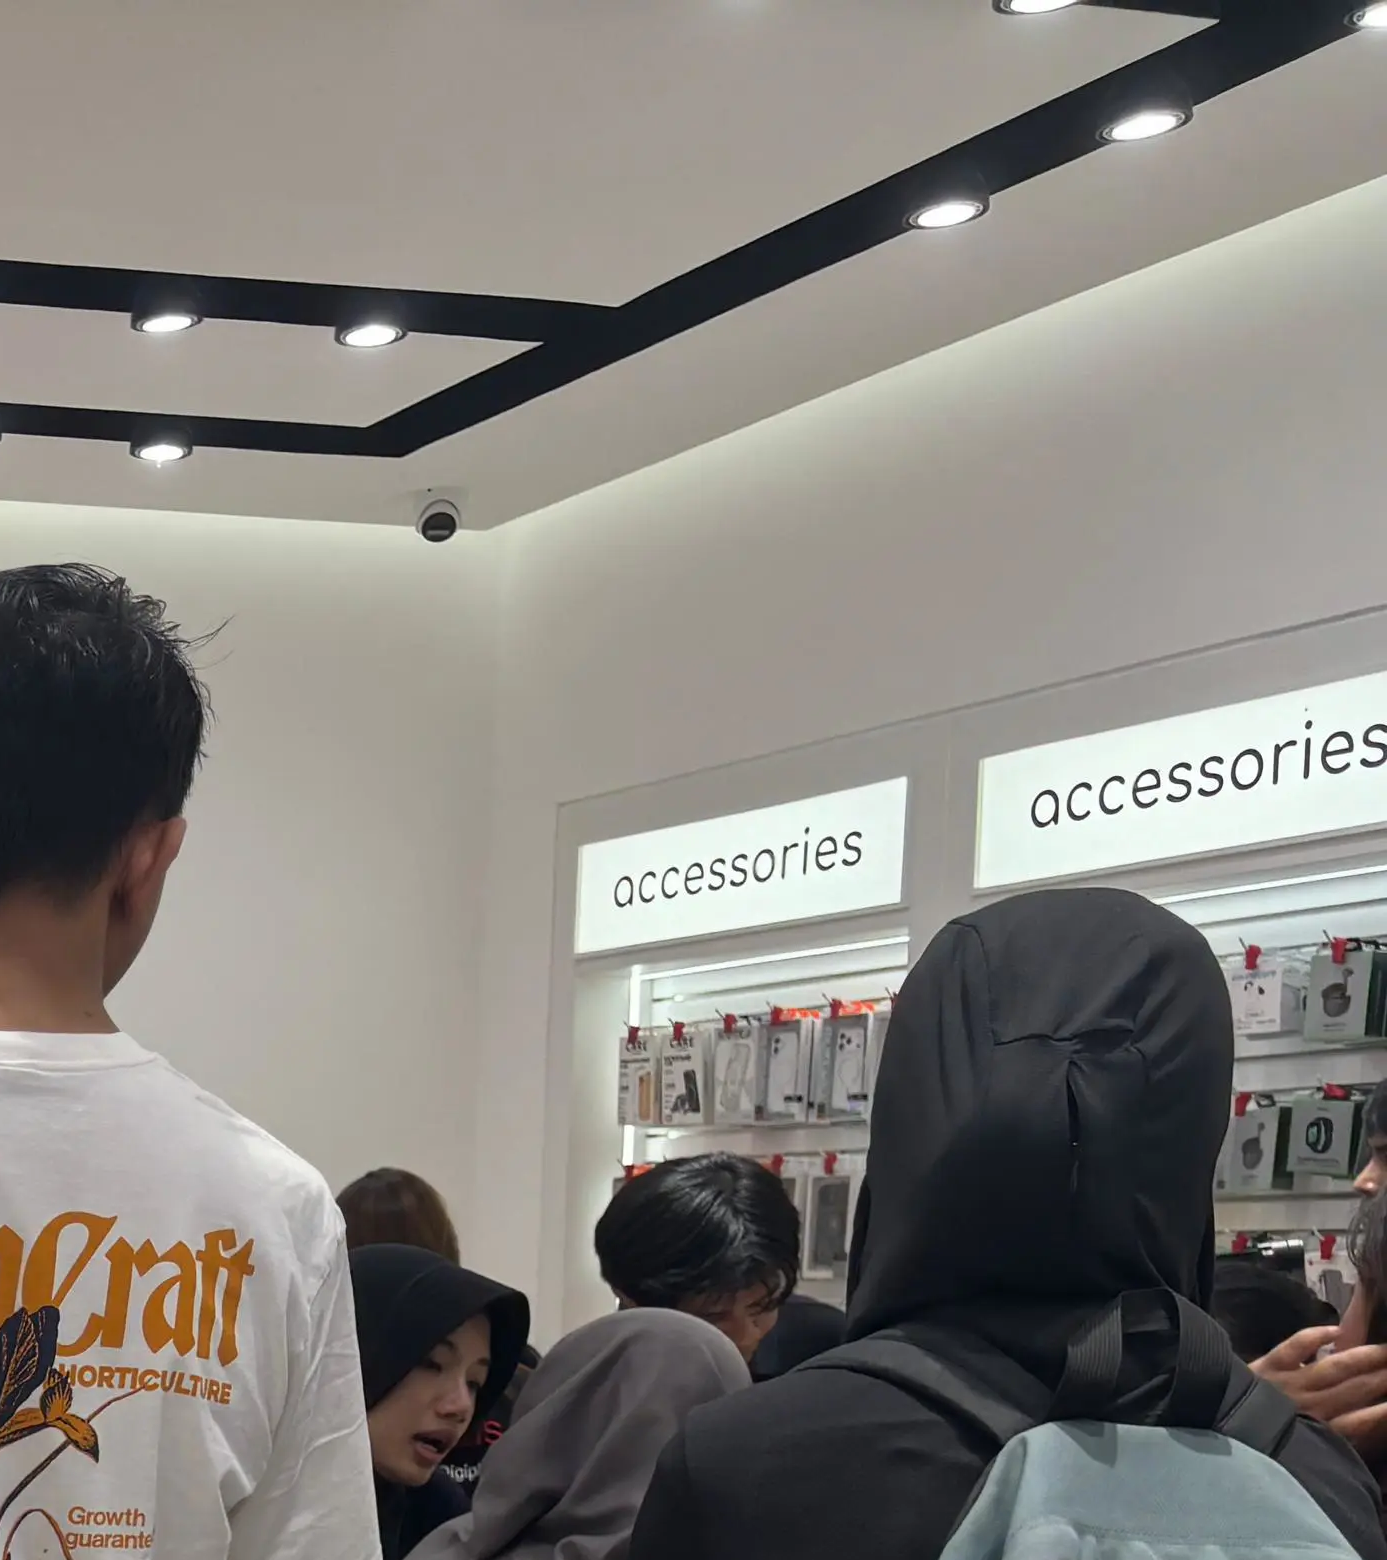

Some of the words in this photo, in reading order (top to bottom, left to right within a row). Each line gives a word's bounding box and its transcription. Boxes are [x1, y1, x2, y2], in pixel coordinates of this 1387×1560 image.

[1031, 719, 1387, 829] accessories
[613, 826, 864, 908] accessories
[58, 1360, 233, 1405] HORTICULTURE
[68, 1506, 146, 1527] Growth
[66, 1532, 154, 1550] guarante
